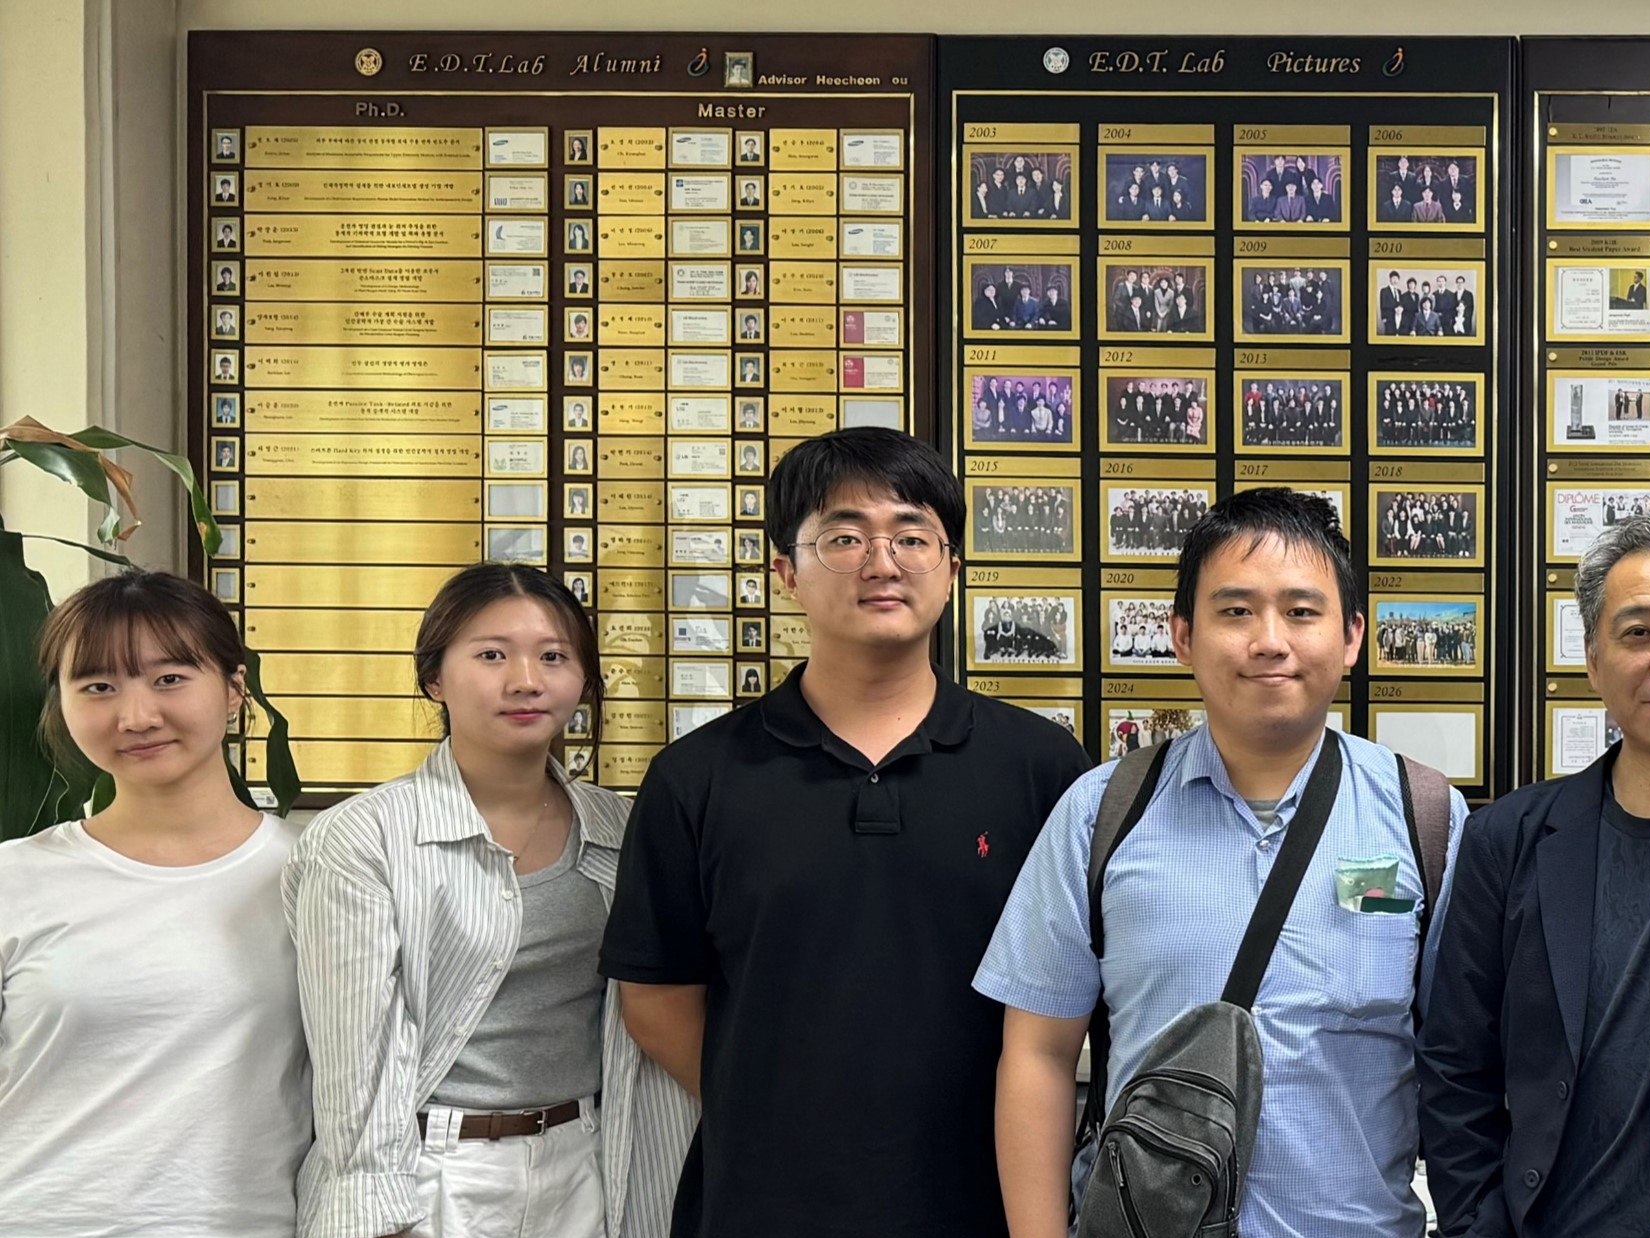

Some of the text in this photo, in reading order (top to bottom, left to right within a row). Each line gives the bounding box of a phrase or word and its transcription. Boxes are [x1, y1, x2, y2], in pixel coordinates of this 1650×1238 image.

[569, 54, 661, 75] Alumni
[1087, 49, 1360, 73] E.D.T. Lab Pictures
[757, 74, 806, 84] Advisor
[816, 74, 880, 84] Heecheon
[355, 102, 405, 118] Ph.D.
[698, 102, 765, 118] Master
[969, 127, 997, 138] 2003
[1104, 128, 1132, 140] 2004
[1239, 129, 1267, 141] 2005
[1374, 130, 1403, 141] 2006
[969, 238, 997, 250] 2007
[1104, 240, 1132, 251] 2008
[1239, 241, 1267, 253] 2009
[1374, 242, 1403, 253] 2010
[969, 350, 997, 361] 2011
[1104, 351, 1132, 363] 2012
[1239, 353, 1267, 364] 2013
[970, 461, 998, 472] 2015
[1105, 463, 1133, 474] 2016
[1240, 464, 1268, 476] 2017
[1374, 464, 1403, 477] 2018
[971, 571, 999, 582] 2019
[1106, 573, 1134, 584] 2020
[1374, 577, 1402, 588] 2022
[972, 681, 1000, 692] 2023
[1107, 683, 1134, 694] 2024
[1374, 686, 1402, 697] 2026
